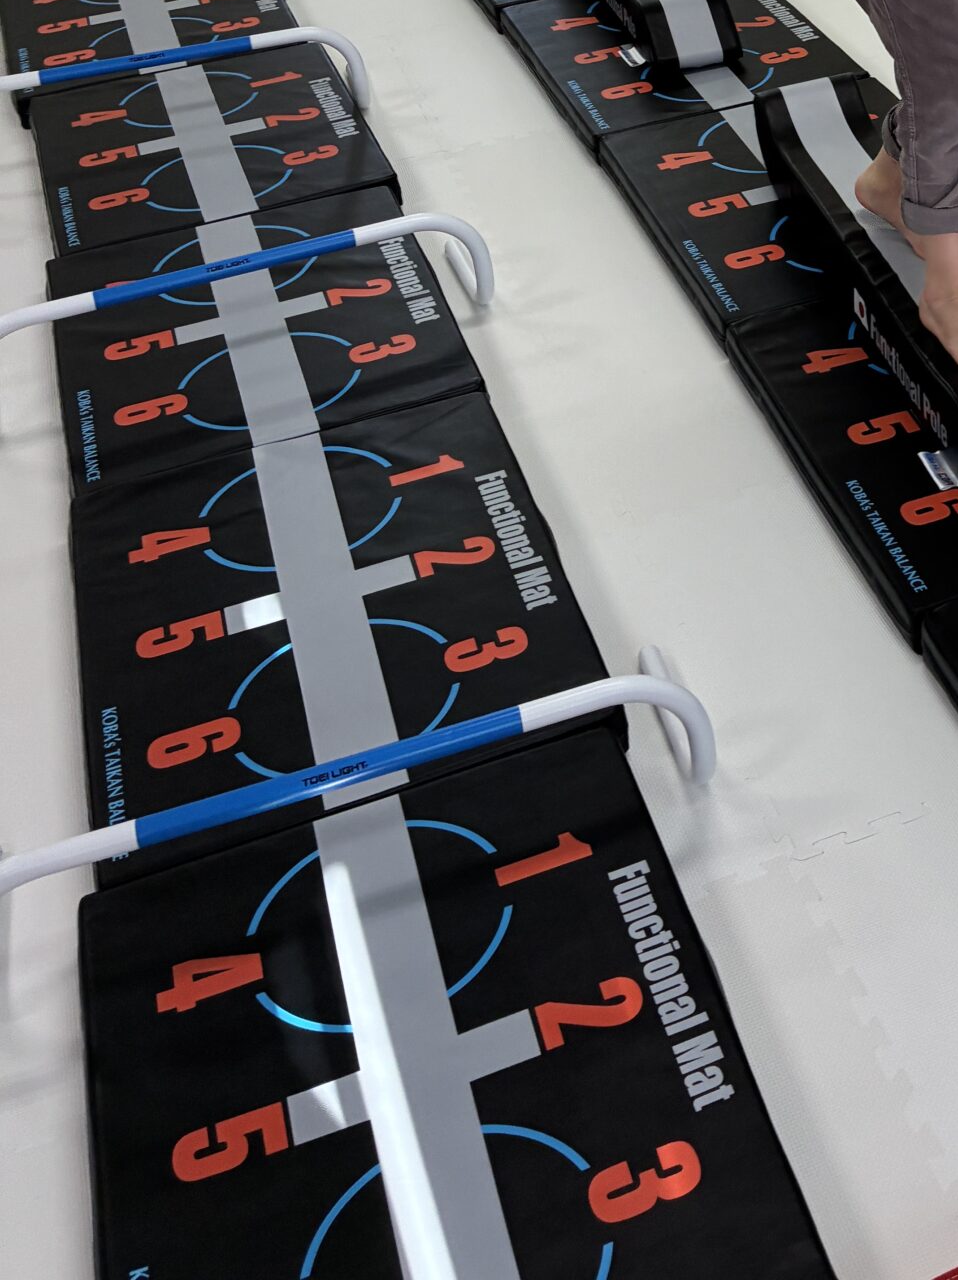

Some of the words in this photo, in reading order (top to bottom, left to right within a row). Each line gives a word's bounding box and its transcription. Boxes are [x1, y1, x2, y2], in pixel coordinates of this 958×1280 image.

[36, 17, 89, 34] 5
[211, 16, 261, 33] 3
[552, 17, 599, 32] 4
[735, 15, 776, 32] 2
[759, 47, 808, 65] 3
[789, 25, 820, 42] Mat
[43, 49, 96, 67] 6
[574, 47, 620, 64] 5
[249, 71, 302, 88] 1
[600, 81, 653, 100] 6
[71, 109, 127, 127] 4
[265, 107, 321, 128] 2
[308, 76, 353, 122] Functional
[331, 118, 360, 139] Mat
[79, 145, 138, 167] 5
[283, 144, 338, 166] 3
[88, 187, 150, 211] 6
[657, 150, 712, 171] 4
[687, 193, 748, 218] 5
[723, 244, 785, 270] 6
[326, 278, 392, 306] 2
[377, 236, 431, 299] Functional
[406, 296, 440, 325] Mat
[711, 282, 740, 313] BALANCE
[103, 330, 175, 361] 5
[348, 334, 417, 364] 3
[802, 347, 868, 374] 4
[847, 410, 920, 445] 5
[870, 314, 921, 411] Functional
[922, 392, 948, 448] Pole
[113, 393, 188, 426] 6
[83, 443, 101, 483] BALANCE
[388, 454, 465, 487] 1
[128, 526, 211, 564] 4
[474, 469, 544, 570] Functional
[513, 565, 558, 611] Mat
[845, 479, 875, 512] KOBA's
[866, 510, 898, 547] TAIKAN
[888, 546, 928, 593] BALANCE
[413, 536, 496, 578] 2
[135, 610, 225, 659] 5
[444, 626, 529, 673] 3
[101, 706, 123, 749] KOBA's
[147, 716, 241, 769] 6
[104, 748, 124, 799] TAIKAN
[302, 771, 330, 787] TOEI
[331, 761, 367, 778] LIGHT
[107, 798, 129, 862] BALE
[495, 832, 594, 888] 1
[155, 952, 264, 1014] 4
[607, 859, 710, 1037] Functional
[671, 1029, 735, 1113] Mat
[534, 976, 643, 1052] 2
[172, 1102, 289, 1183] 5
[587, 1140, 702, 1224] 3
